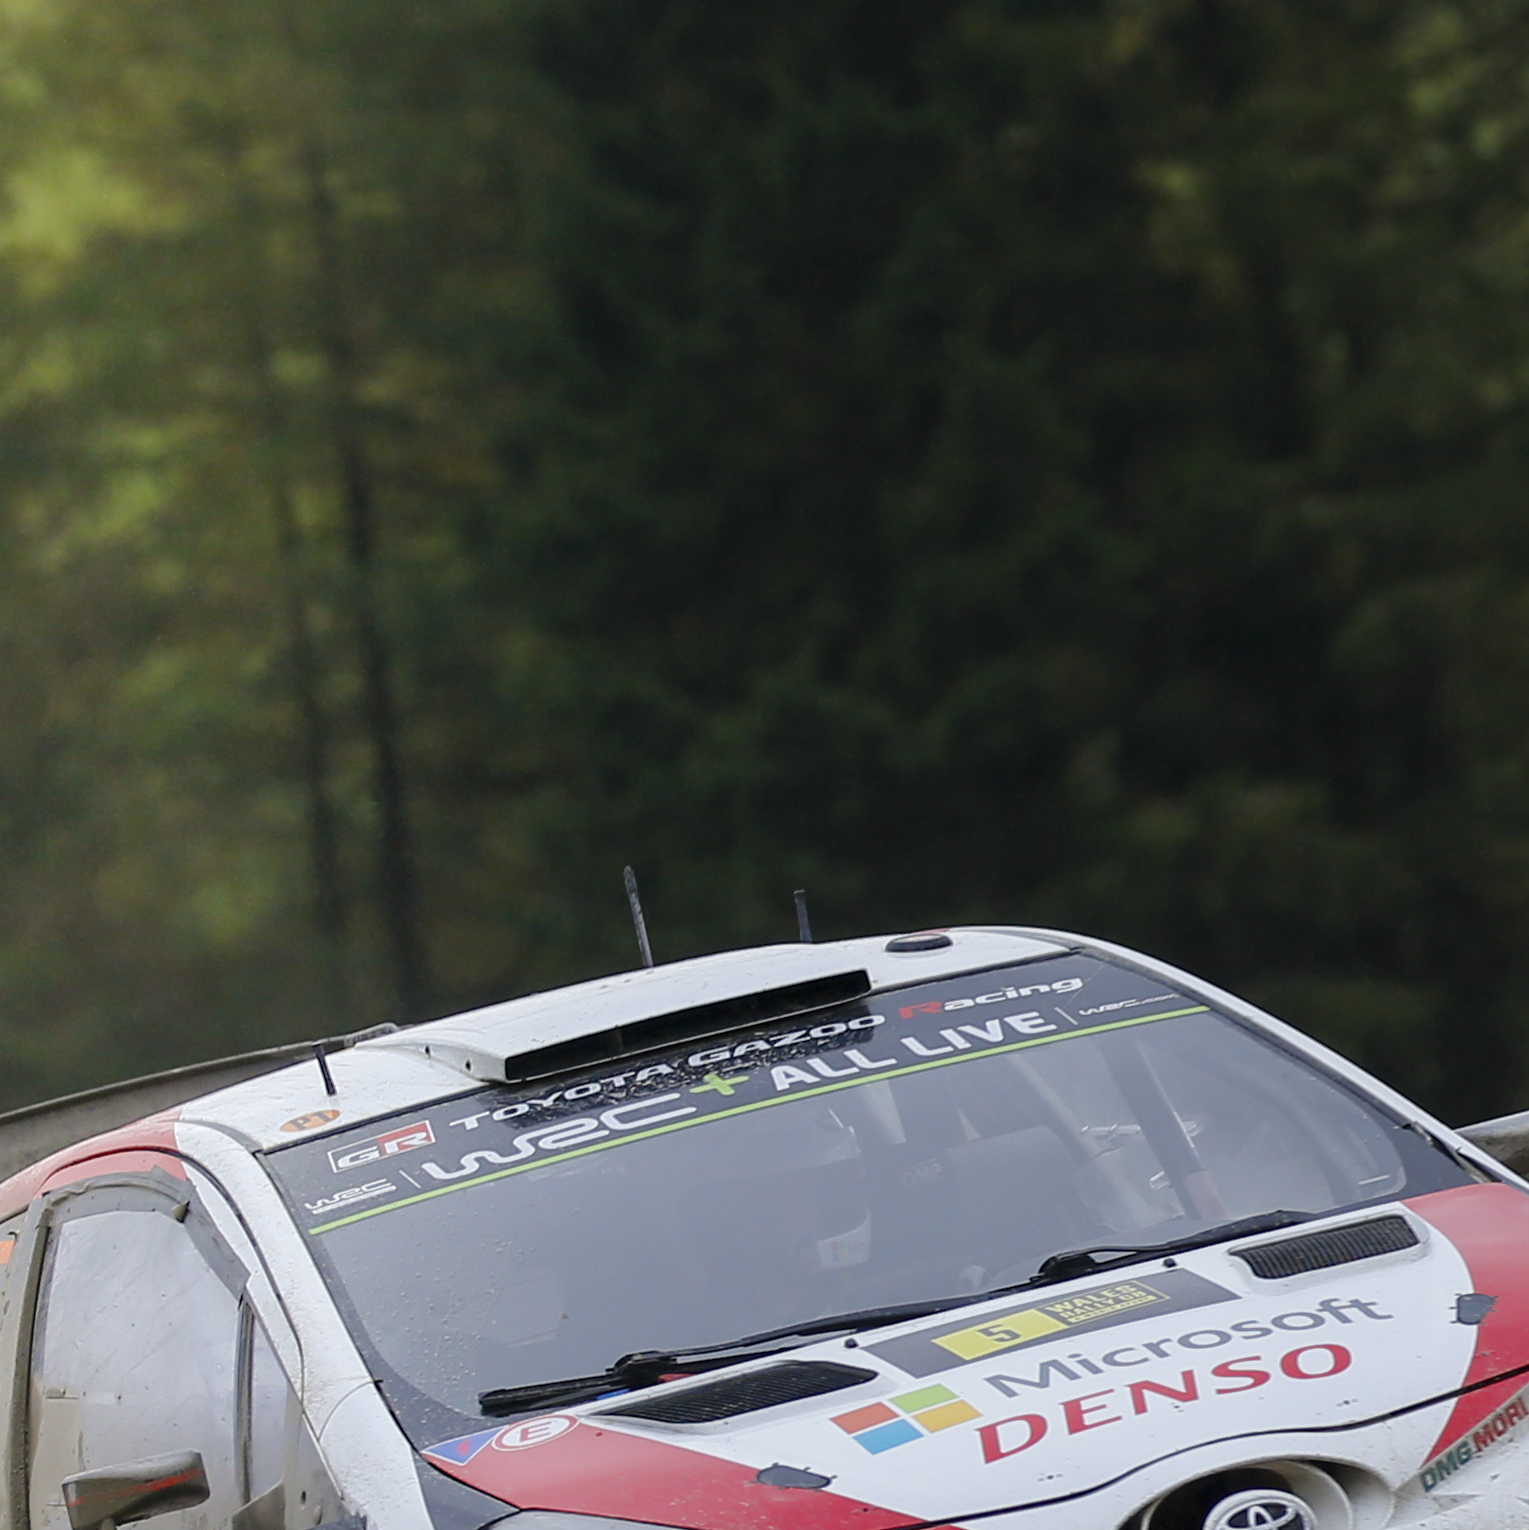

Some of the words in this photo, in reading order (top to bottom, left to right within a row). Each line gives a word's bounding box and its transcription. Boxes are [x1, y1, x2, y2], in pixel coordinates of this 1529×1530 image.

[449, 1063, 674, 1131] TOYOTA
[688, 1014, 886, 1067] GAZOO
[898, 977, 1085, 1019] Racing
[770, 1049, 898, 1091] ALL
[900, 1011, 1058, 1057] LIVE
[337, 1131, 428, 1169] GR
[976, 1324, 1021, 1343] 5
[1045, 1285, 1138, 1313] WALES
[983, 1297, 1394, 1399] Microsoft
[975, 1343, 1352, 1465] DENSO
[1420, 1440, 1474, 1493] DMG
[1473, 1396, 1529, 1453] MORI
